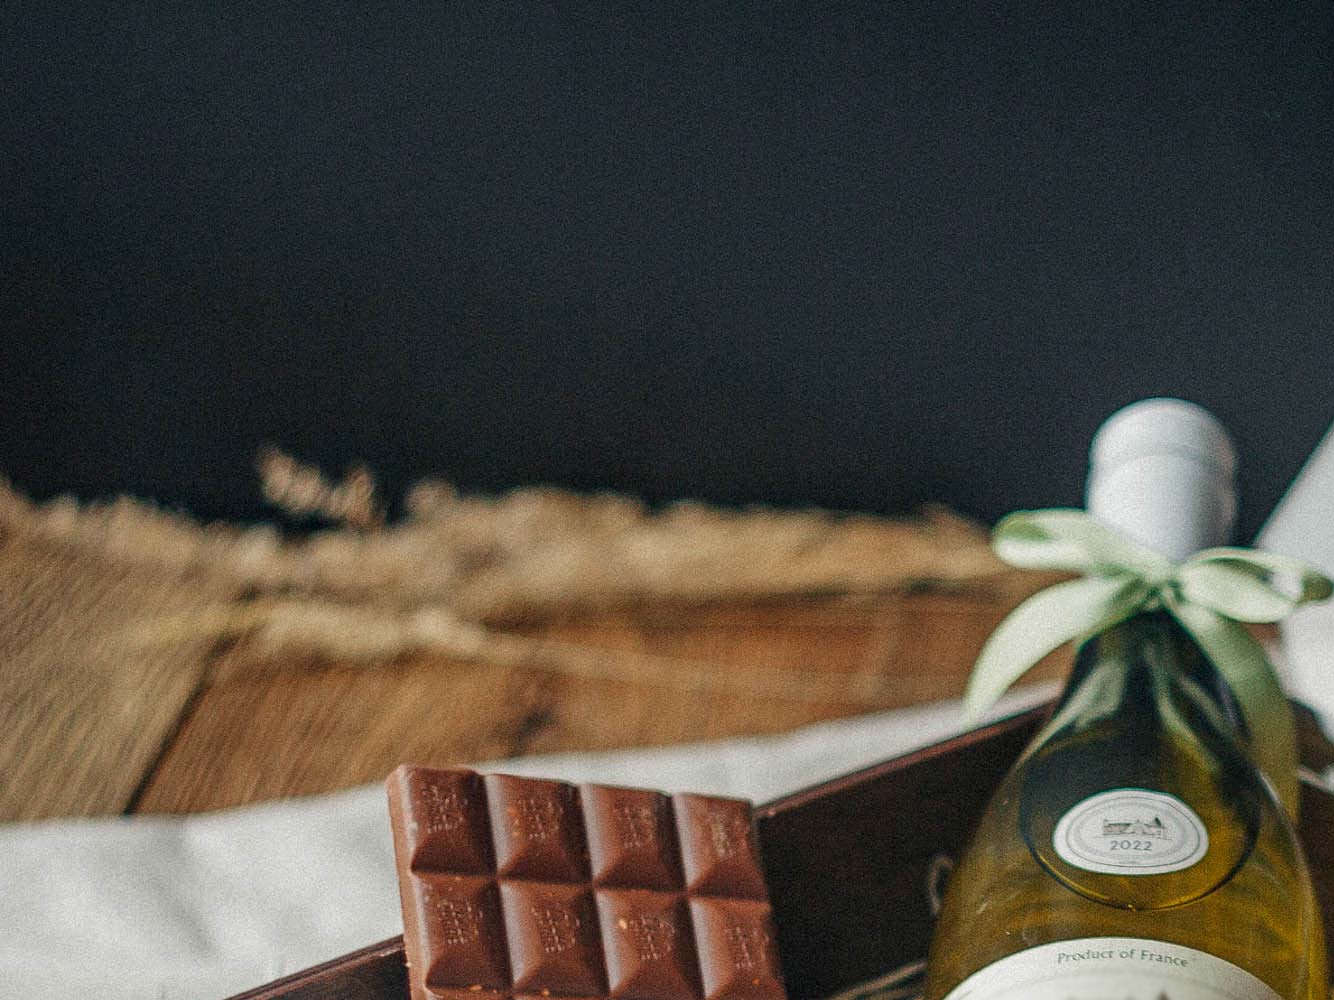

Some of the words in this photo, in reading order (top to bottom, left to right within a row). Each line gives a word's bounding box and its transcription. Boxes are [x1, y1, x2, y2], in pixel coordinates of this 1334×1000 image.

[1110, 840, 1152, 851] 2022
[1057, 949, 1113, 964] Product
[1119, 948, 1135, 958] of
[1140, 949, 1188, 967] France
